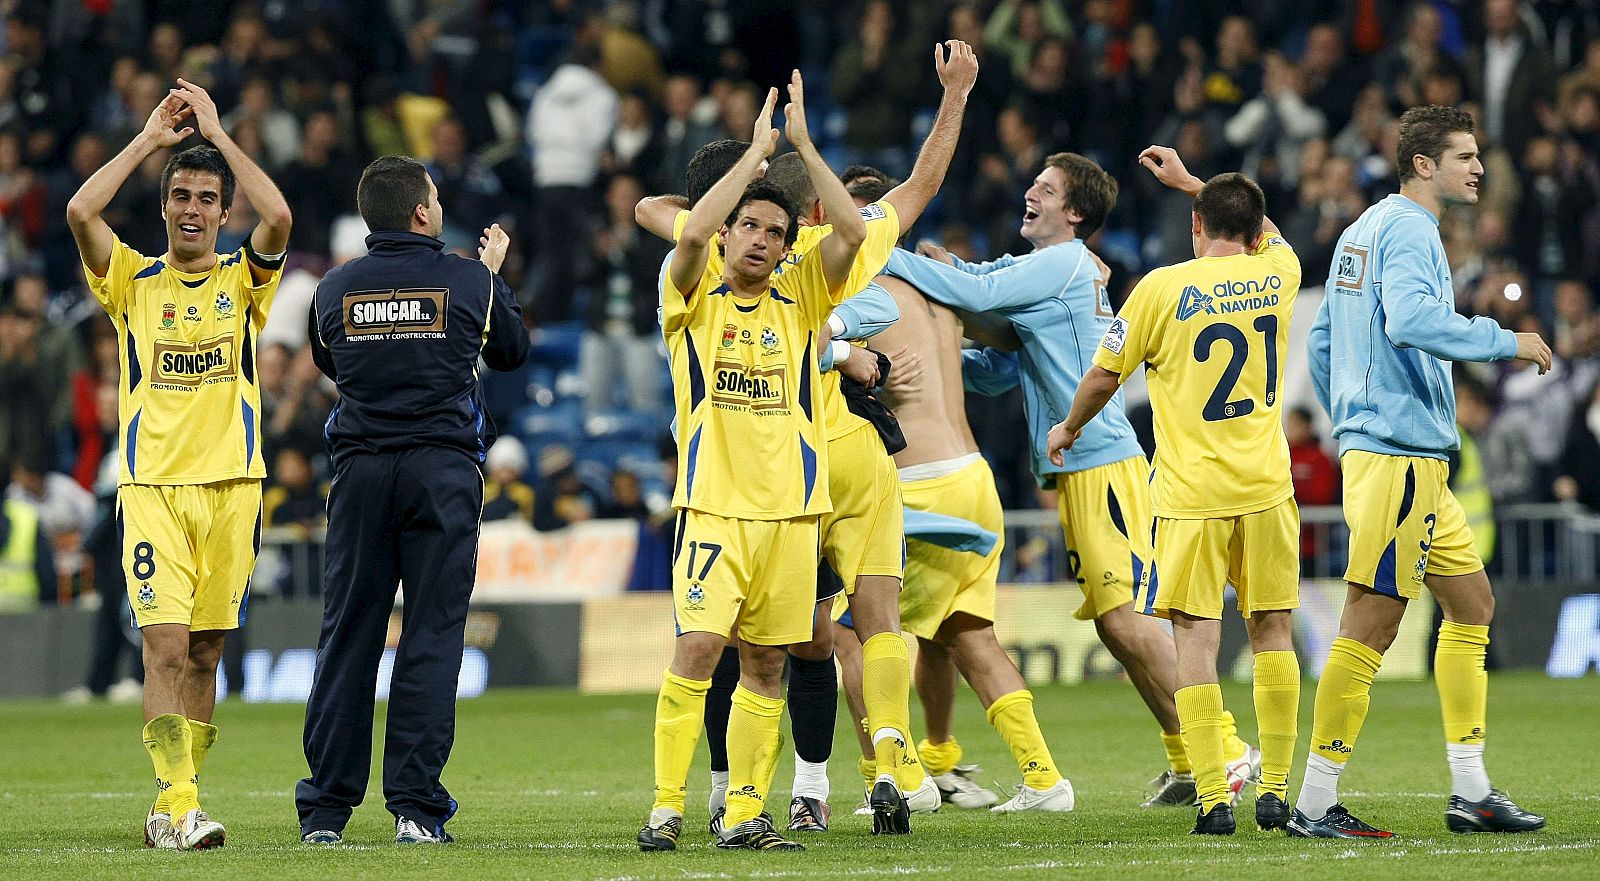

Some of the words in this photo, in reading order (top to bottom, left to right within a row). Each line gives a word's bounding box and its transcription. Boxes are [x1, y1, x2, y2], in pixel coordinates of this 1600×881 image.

[1213, 275, 1281, 298] alonso
[353, 301, 421, 323] SONCAR
[1219, 293, 1279, 314] NAVIDAD
[346, 334, 384, 343] PROMOTORA
[391, 332, 447, 340] CONSTRUCTORA
[163, 348, 222, 374] SONCAR
[1193, 313, 1278, 422] 21
[150, 383, 193, 392] PROMOTORA
[716, 370, 771, 399] SONCAR
[1419, 512, 1437, 553] 3
[133, 542, 155, 580] 8
[686, 540, 723, 581] 17
